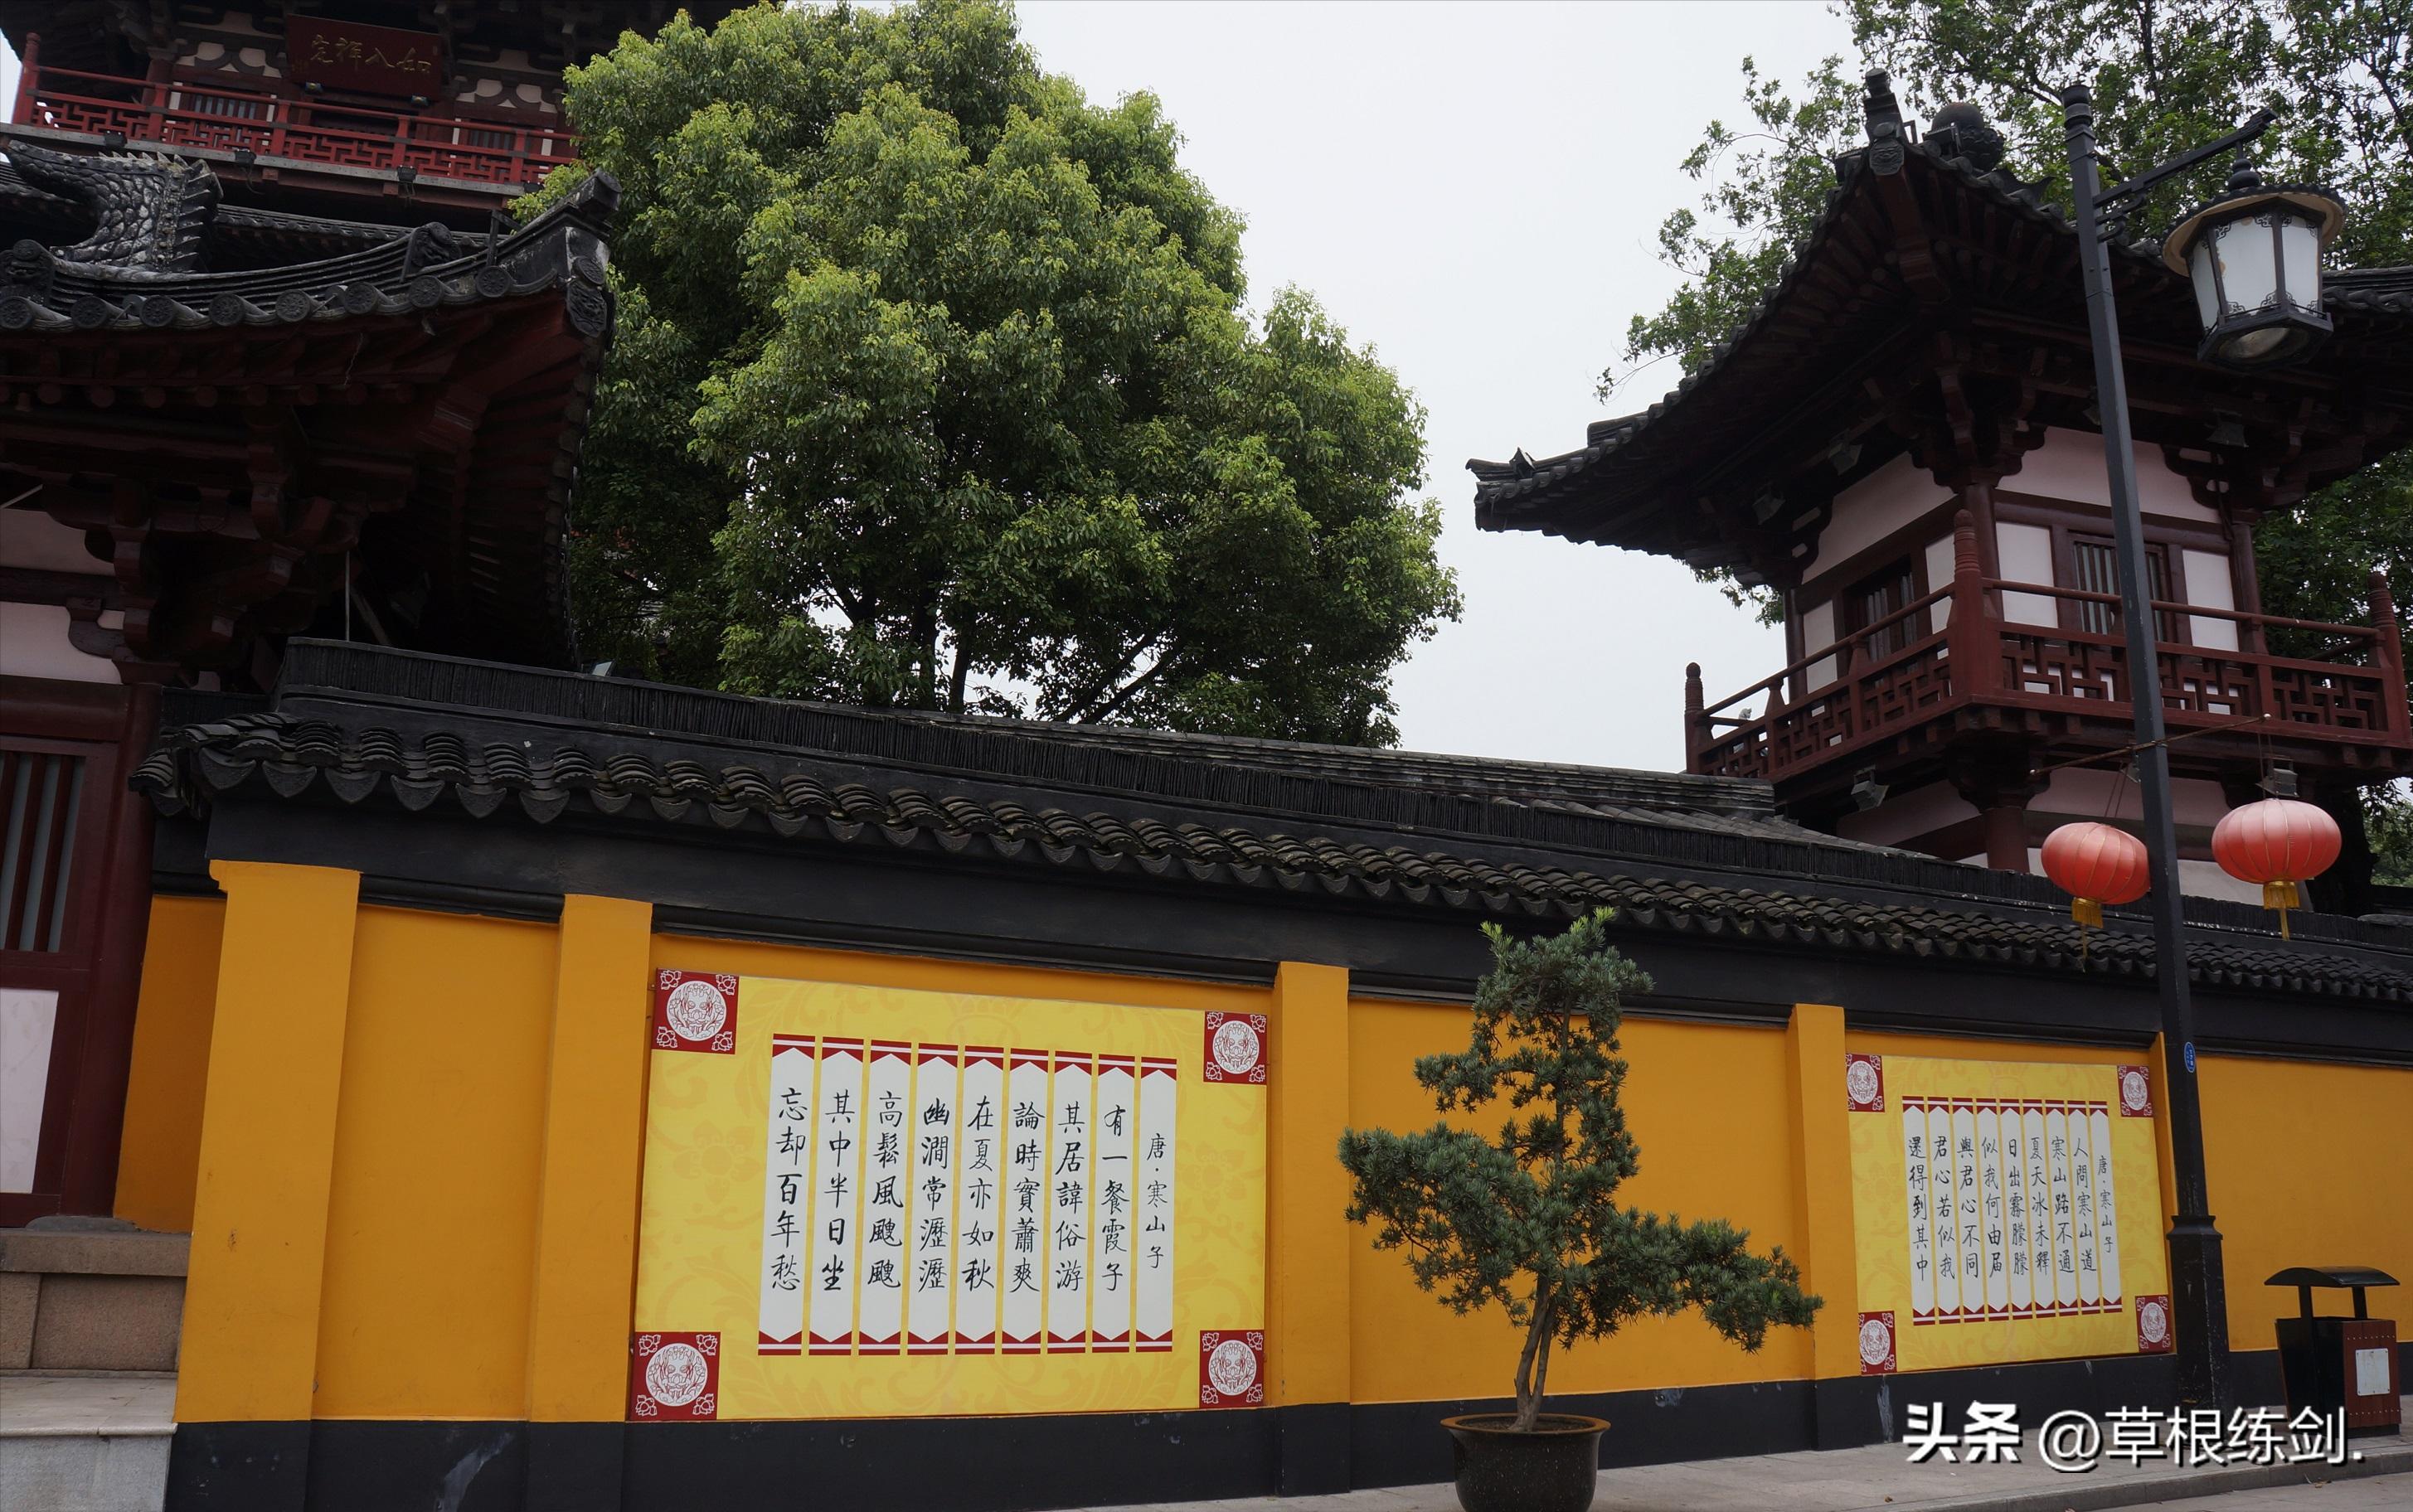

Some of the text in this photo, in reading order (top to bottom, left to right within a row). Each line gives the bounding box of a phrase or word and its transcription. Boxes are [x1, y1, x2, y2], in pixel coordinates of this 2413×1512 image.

[822, 1089, 855, 1291] 其中半日坐
[962, 1096, 994, 1292] 在夏亦如秋
[1101, 1105, 1129, 1291] 有一餐霞子
[1908, 1136, 1928, 1281] 還得到其中
[1934, 1136, 1954, 1279] 君心若似我
[1957, 1136, 1979, 1278] 與君心不同
[2030, 1137, 2049, 1274] 夏天冰未釋
[2051, 1136, 2076, 1272] 寒山路不通
[2072, 1138, 2096, 1272] 人問寒山道
